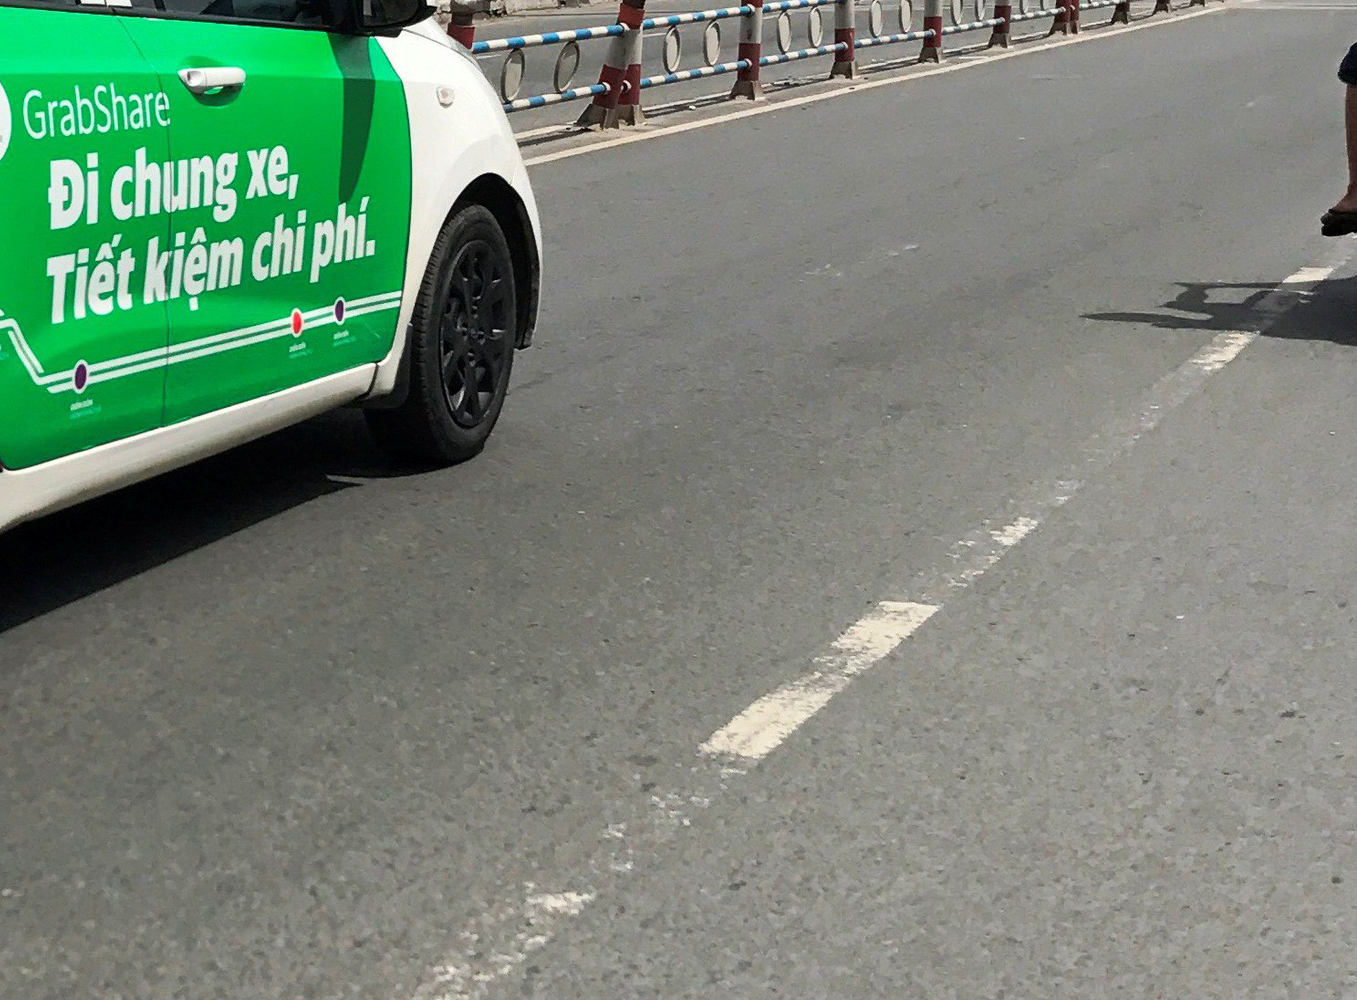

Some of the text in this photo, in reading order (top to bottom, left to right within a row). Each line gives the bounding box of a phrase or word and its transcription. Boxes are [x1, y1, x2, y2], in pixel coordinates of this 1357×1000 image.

[23, 82, 171, 140] GrabShare
[47, 144, 299, 231] Đi chung xe,
[46, 196, 376, 324] Tiết kiệm chi phí.
